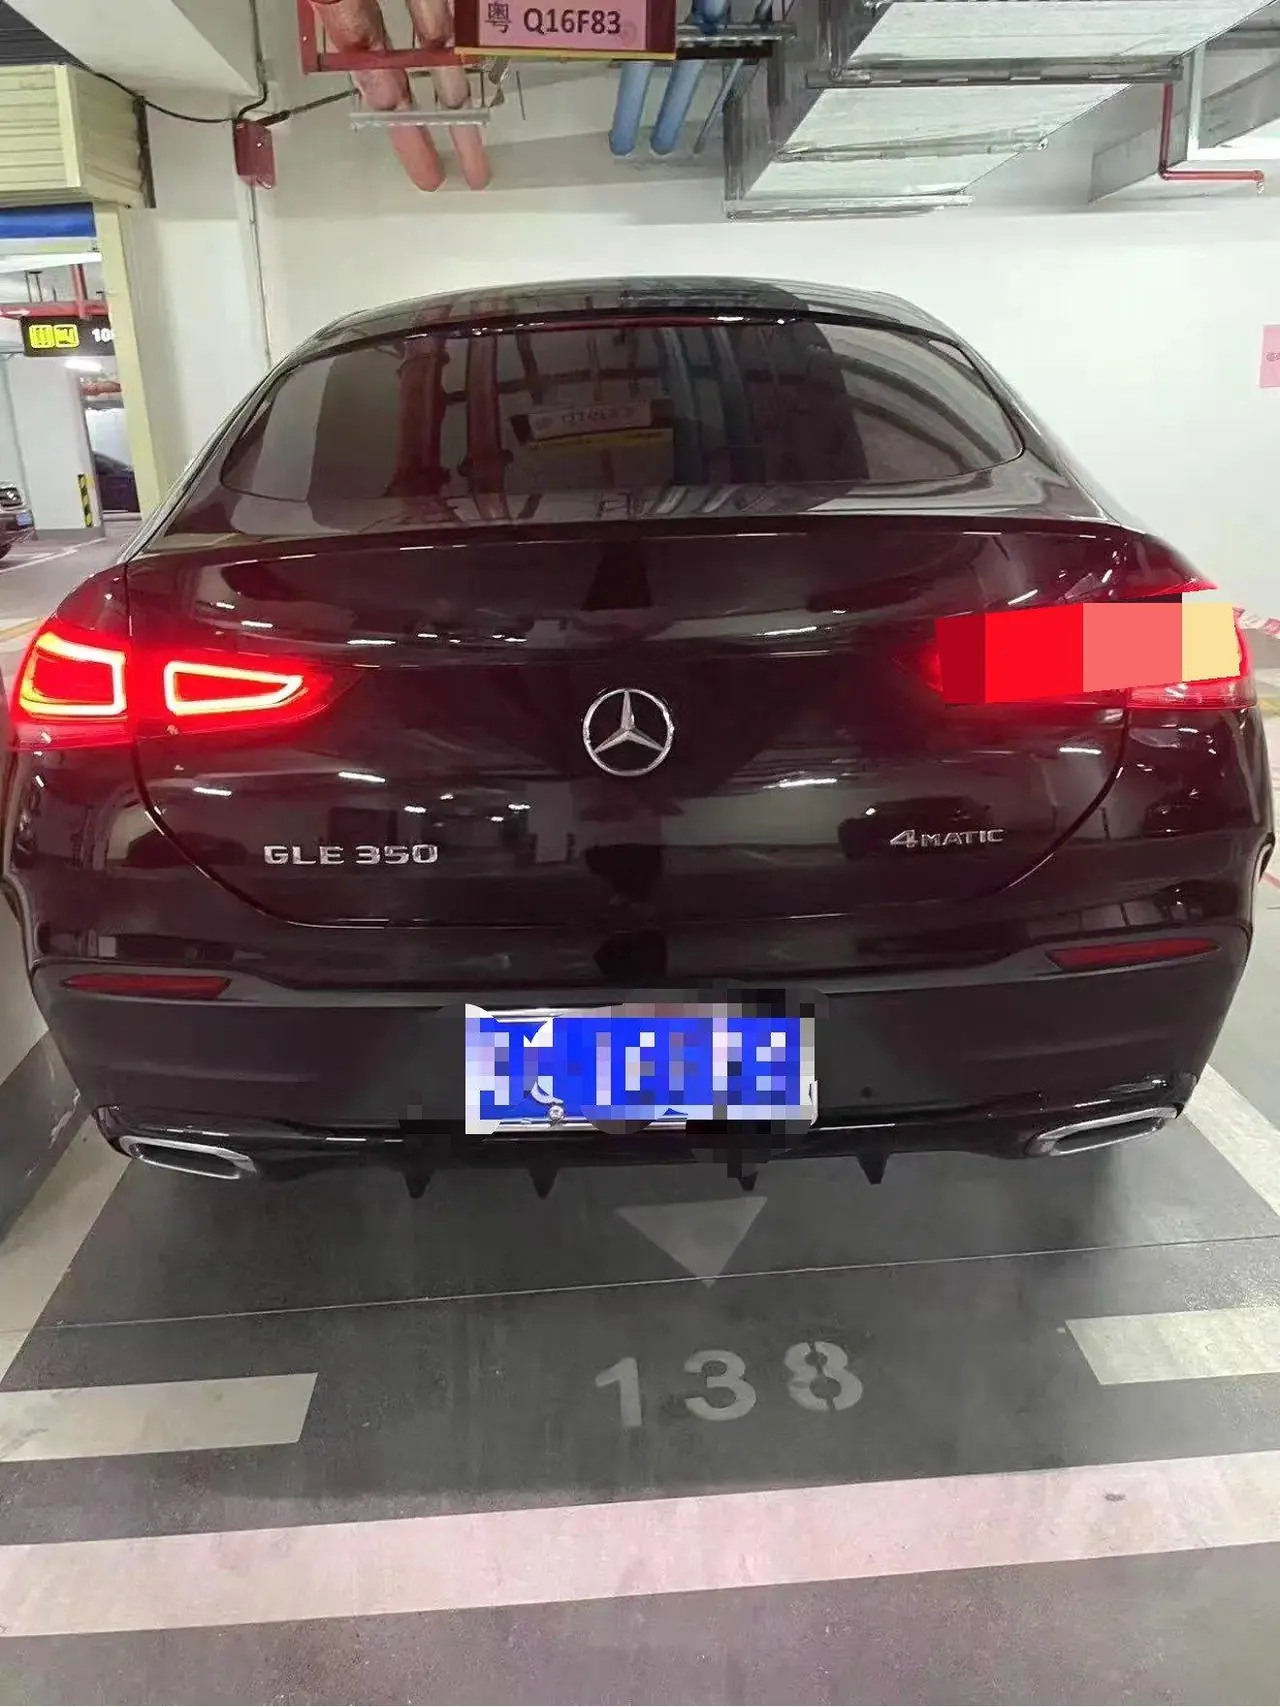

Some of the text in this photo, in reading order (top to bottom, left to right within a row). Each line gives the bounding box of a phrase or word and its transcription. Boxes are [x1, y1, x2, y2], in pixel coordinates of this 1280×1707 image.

[485, 1, 621, 35] 粤 Q16F83
[889, 829, 1005, 848] 4MATIC
[264, 844, 438, 865] GLE 350
[595, 1341, 864, 1427] 138
